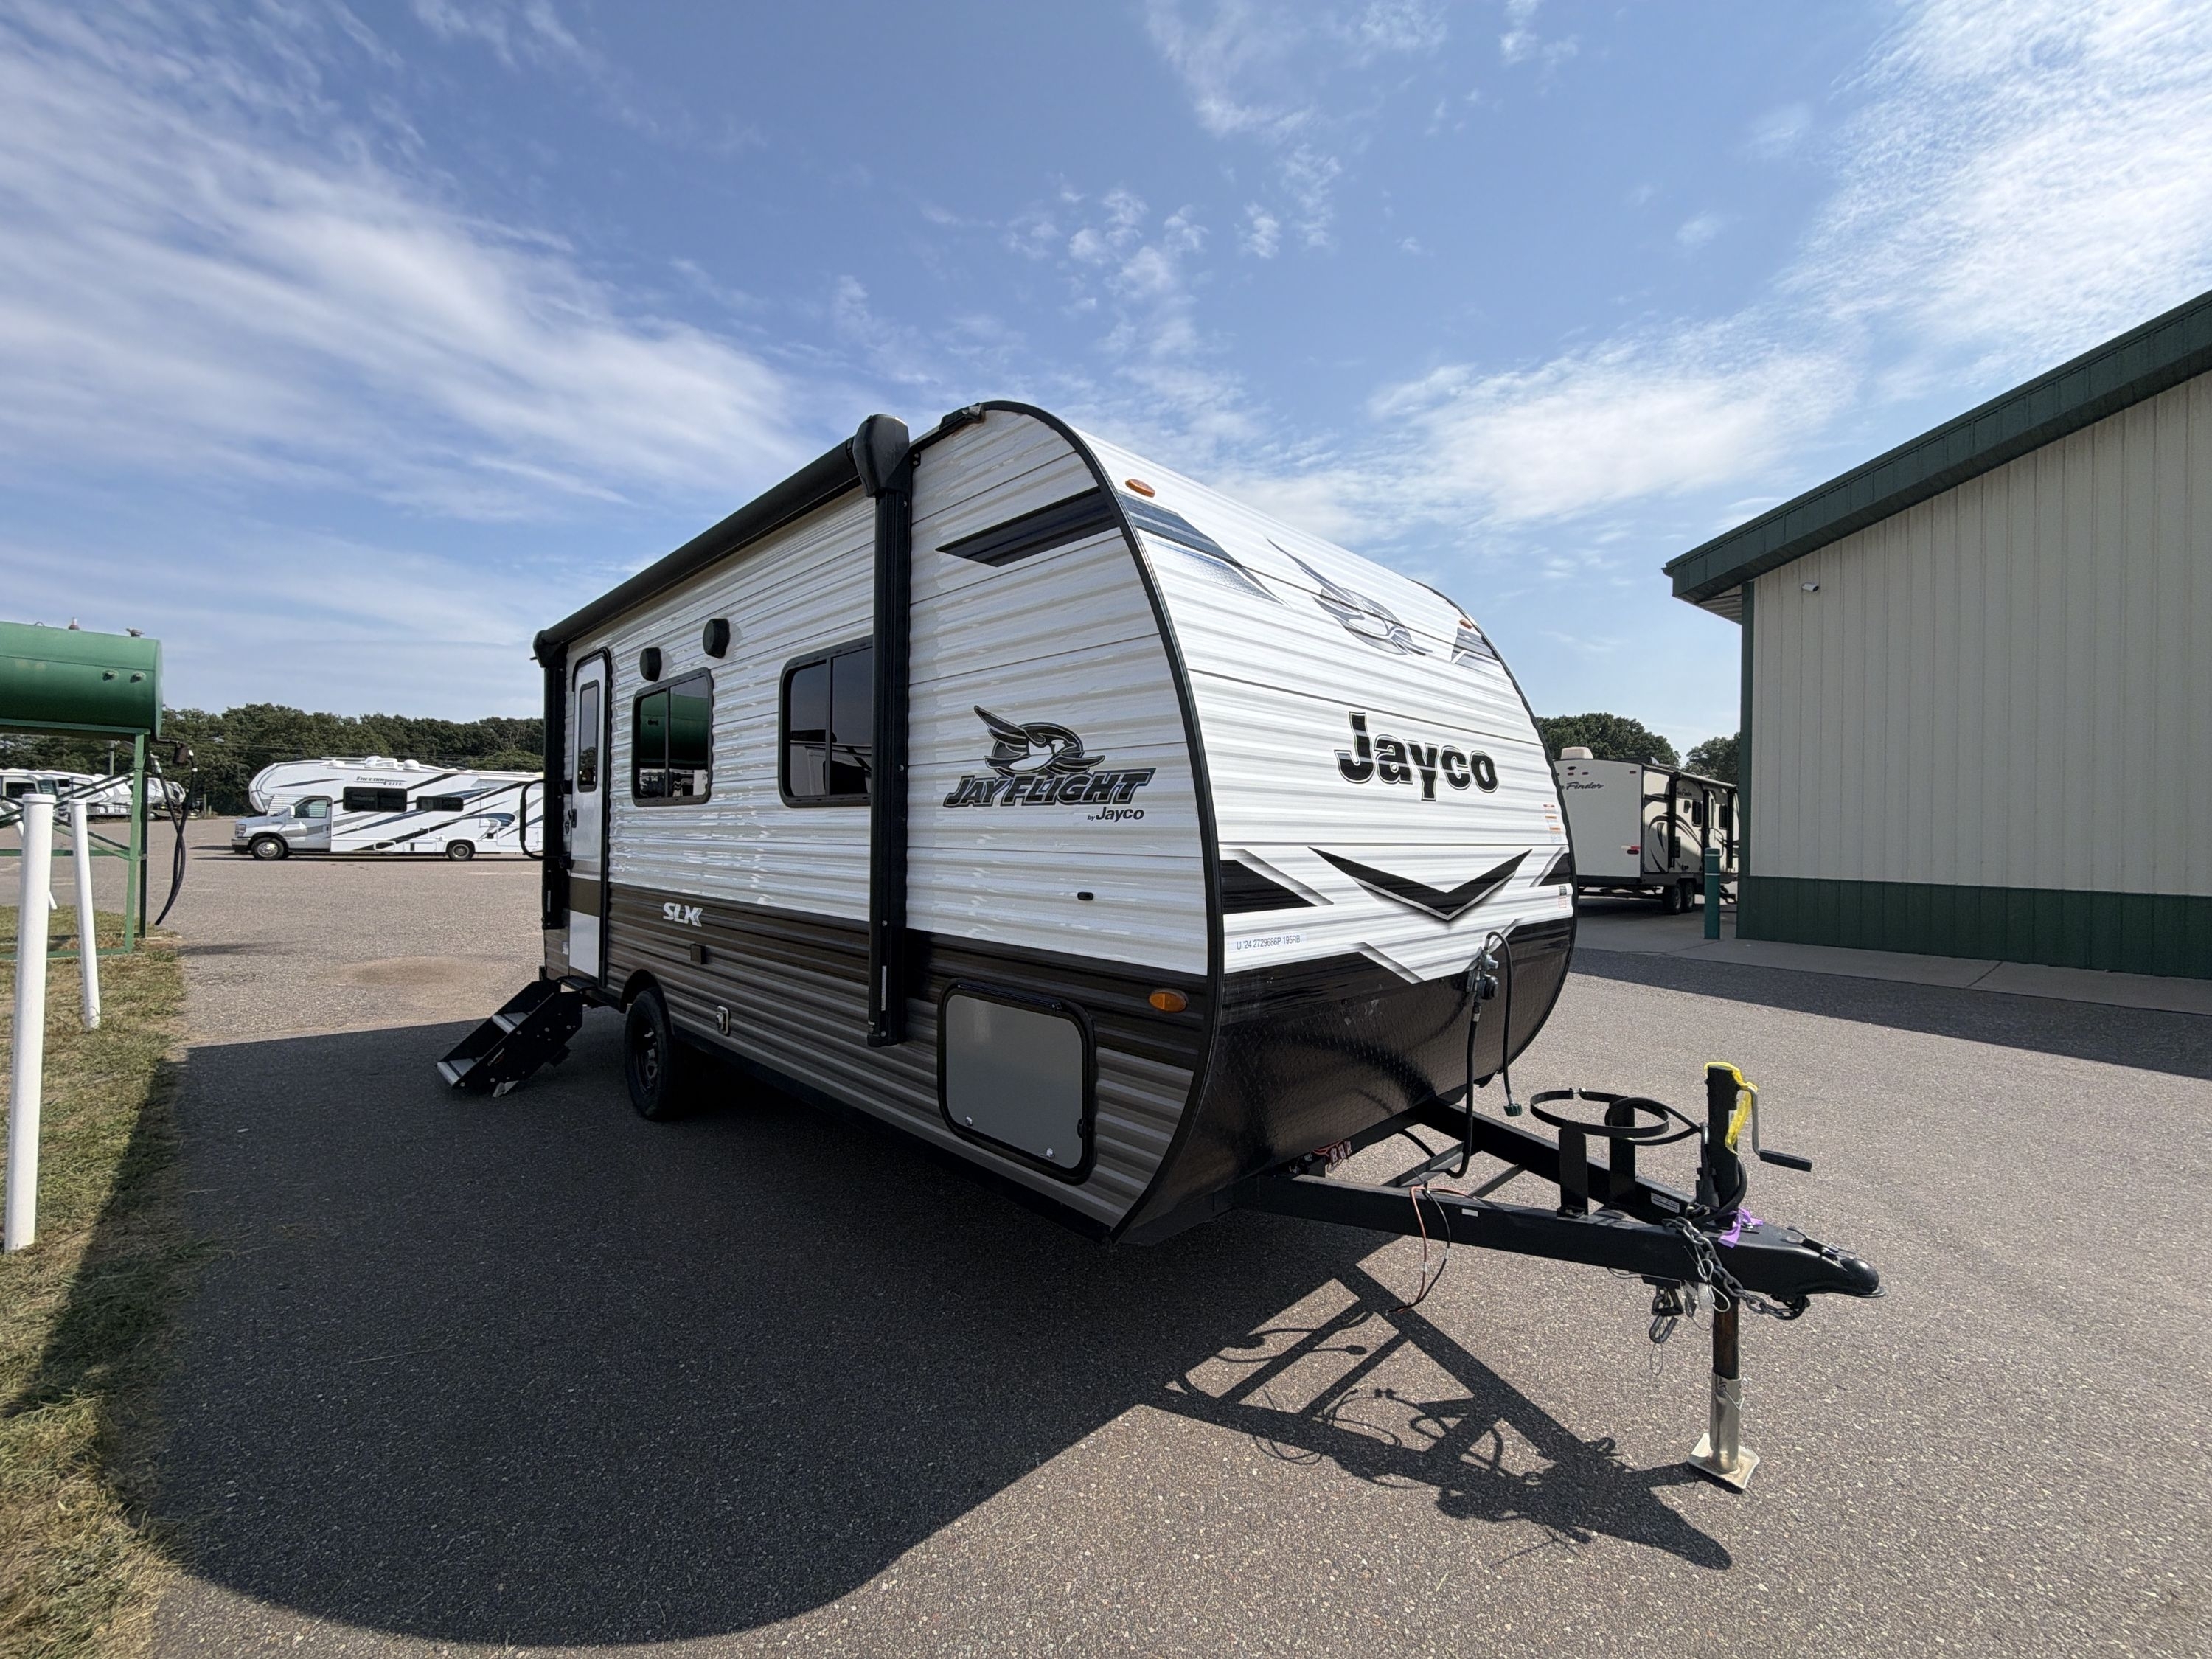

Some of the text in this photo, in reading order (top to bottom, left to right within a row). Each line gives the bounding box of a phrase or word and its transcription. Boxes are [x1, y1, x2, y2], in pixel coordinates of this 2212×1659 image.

[1334, 711, 1499, 801] Jayco
[943, 768, 1156, 807] JAY FLIGHT
[1566, 782, 1604, 790] Finder
[1096, 807, 1144, 822] Jayco
[663, 902, 703, 928] SLX
[1237, 940, 1242, 950] U
[1283, 935, 1301, 945] 195RB
